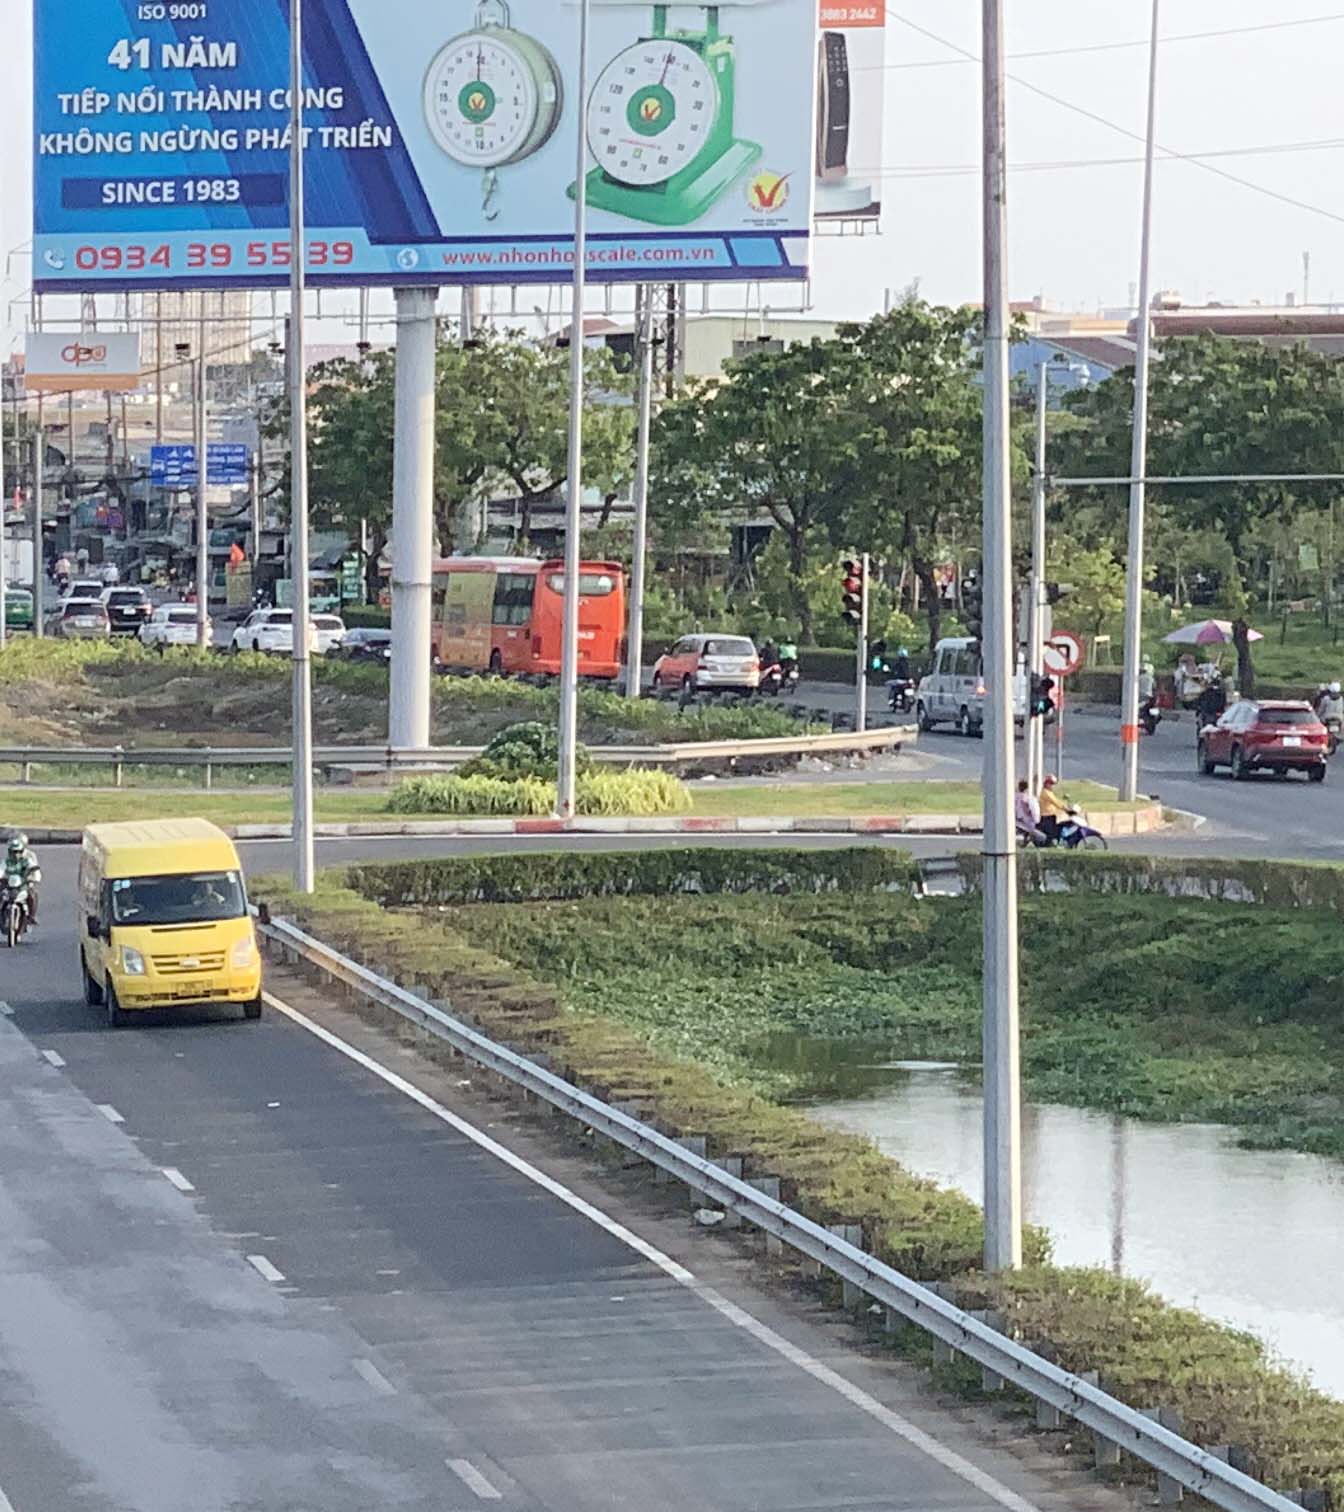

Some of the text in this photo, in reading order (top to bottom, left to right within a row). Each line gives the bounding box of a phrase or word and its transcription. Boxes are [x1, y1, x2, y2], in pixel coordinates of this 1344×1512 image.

[138, 3, 207, 20] ISO 9001
[107, 35, 237, 70] 41 NĂM
[57, 86, 110, 115] TIẾP
[117, 85, 165, 114] NỐI
[171, 84, 262, 112] THÀNH
[39, 127, 133, 155] KHÔNG
[140, 123, 239, 153] NGỪNG
[318, 117, 393, 149] TRIỂN
[102, 180, 240, 204] SINCE 1983
[75, 244, 171, 270] 0934
[186, 243, 232, 268] 39
[442, 246, 715, 265] www.nhonhoscale.com.vn
